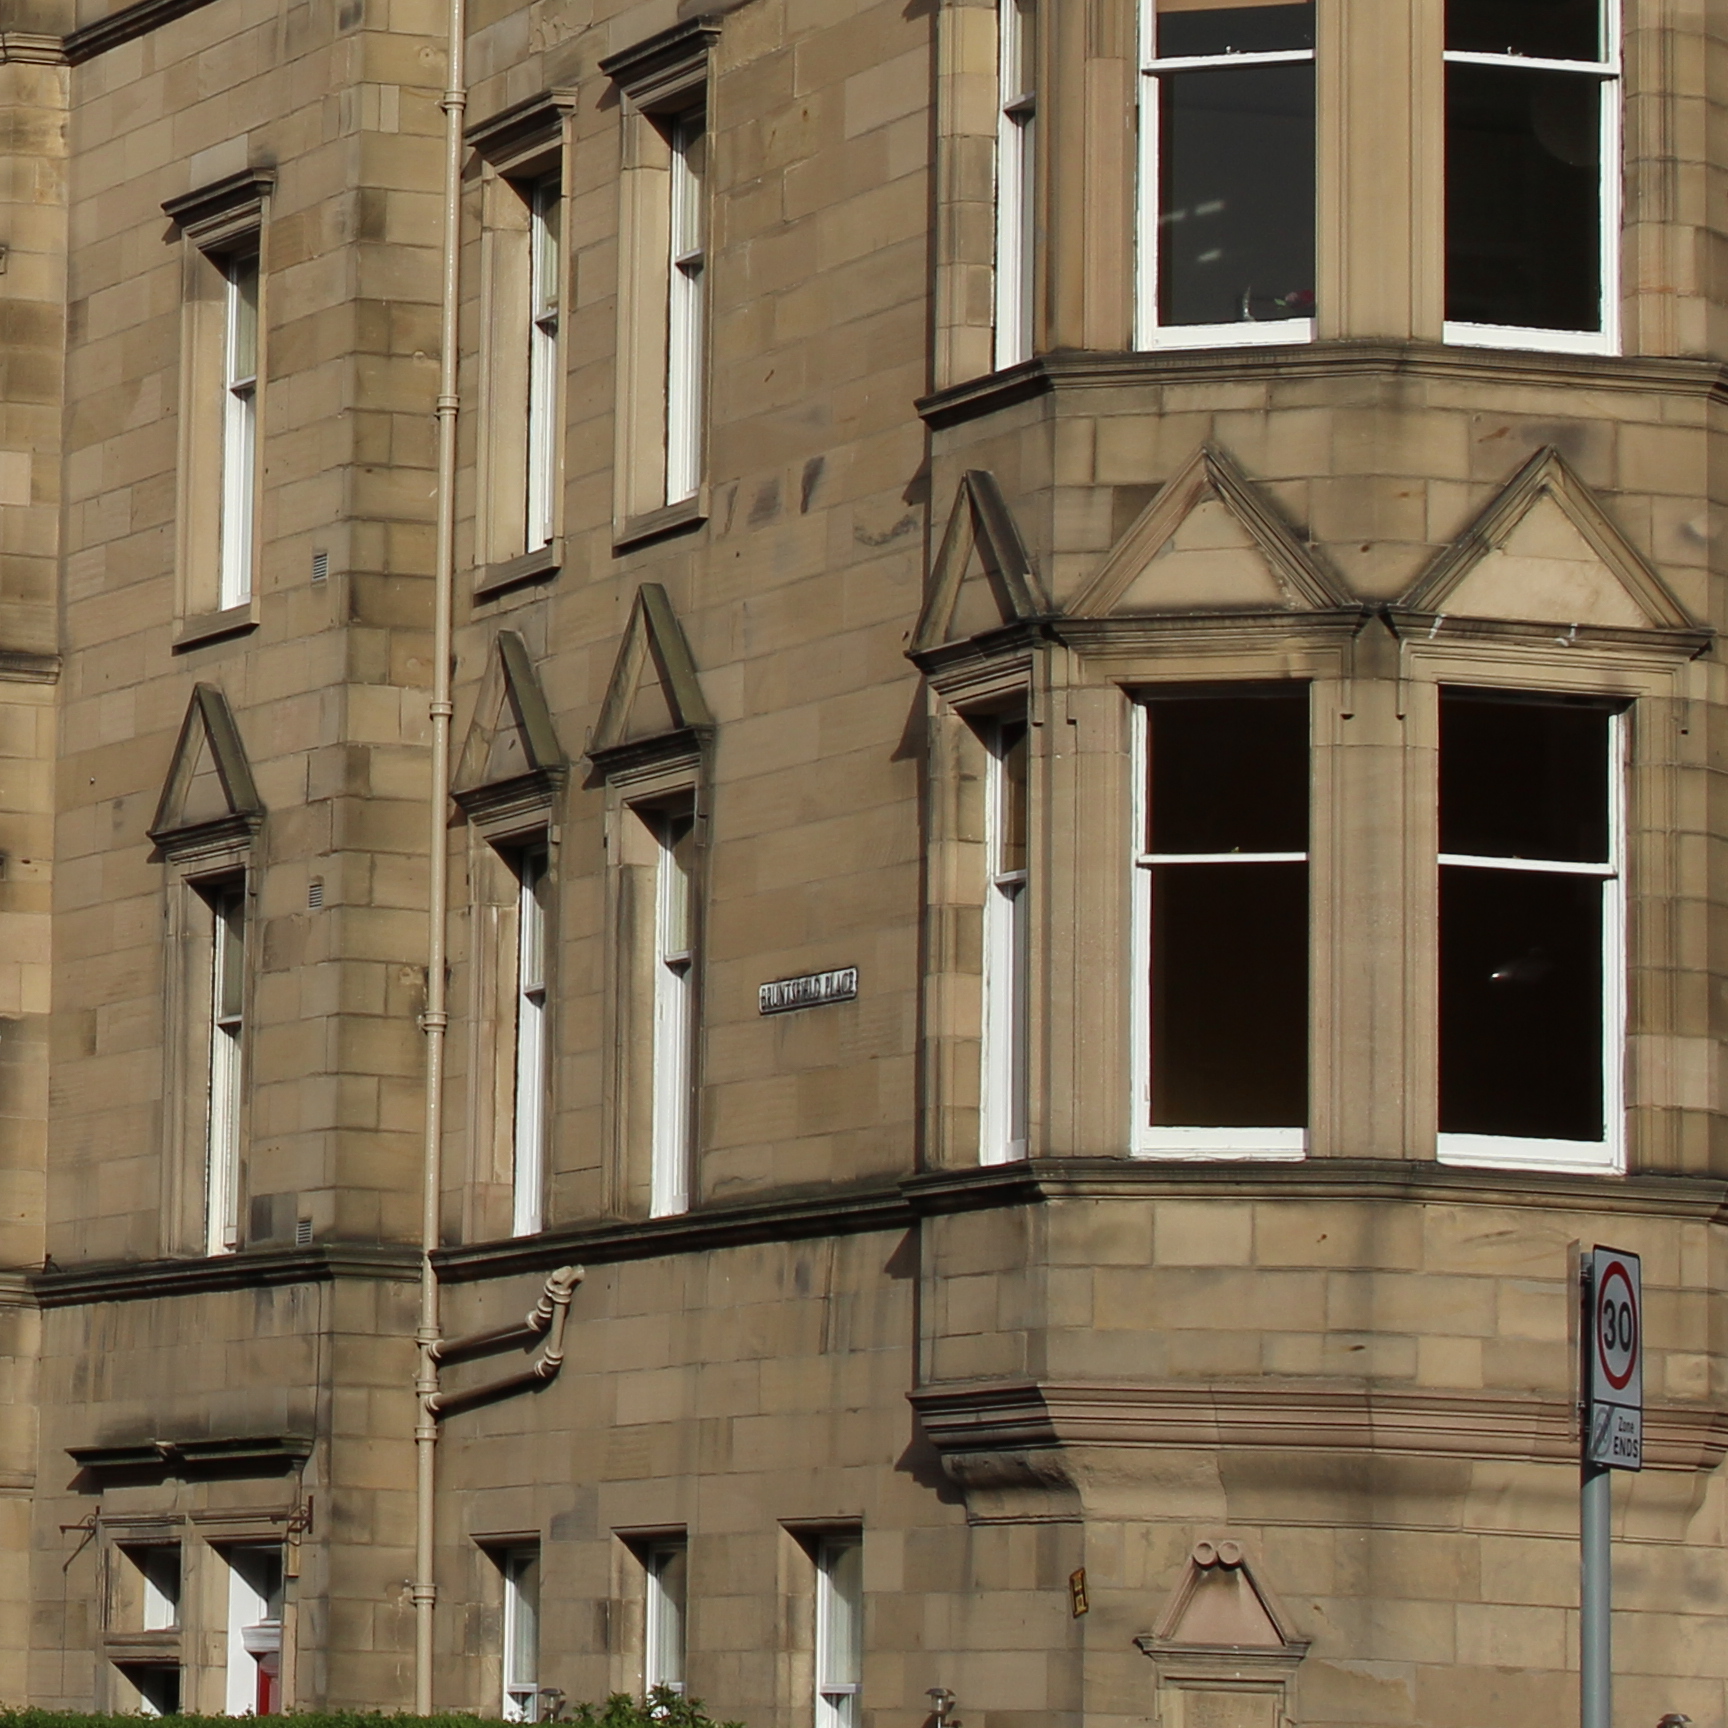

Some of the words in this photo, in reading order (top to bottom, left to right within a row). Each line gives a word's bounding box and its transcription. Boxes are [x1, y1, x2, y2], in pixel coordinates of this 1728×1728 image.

[761, 977, 821, 1010] BRUNTSFIELD
[825, 971, 854, 997] PLACE
[1603, 1299, 1632, 1353] 30
[1618, 1416, 1634, 1434] Zone
[1613, 1435, 1639, 1458] ENDS
